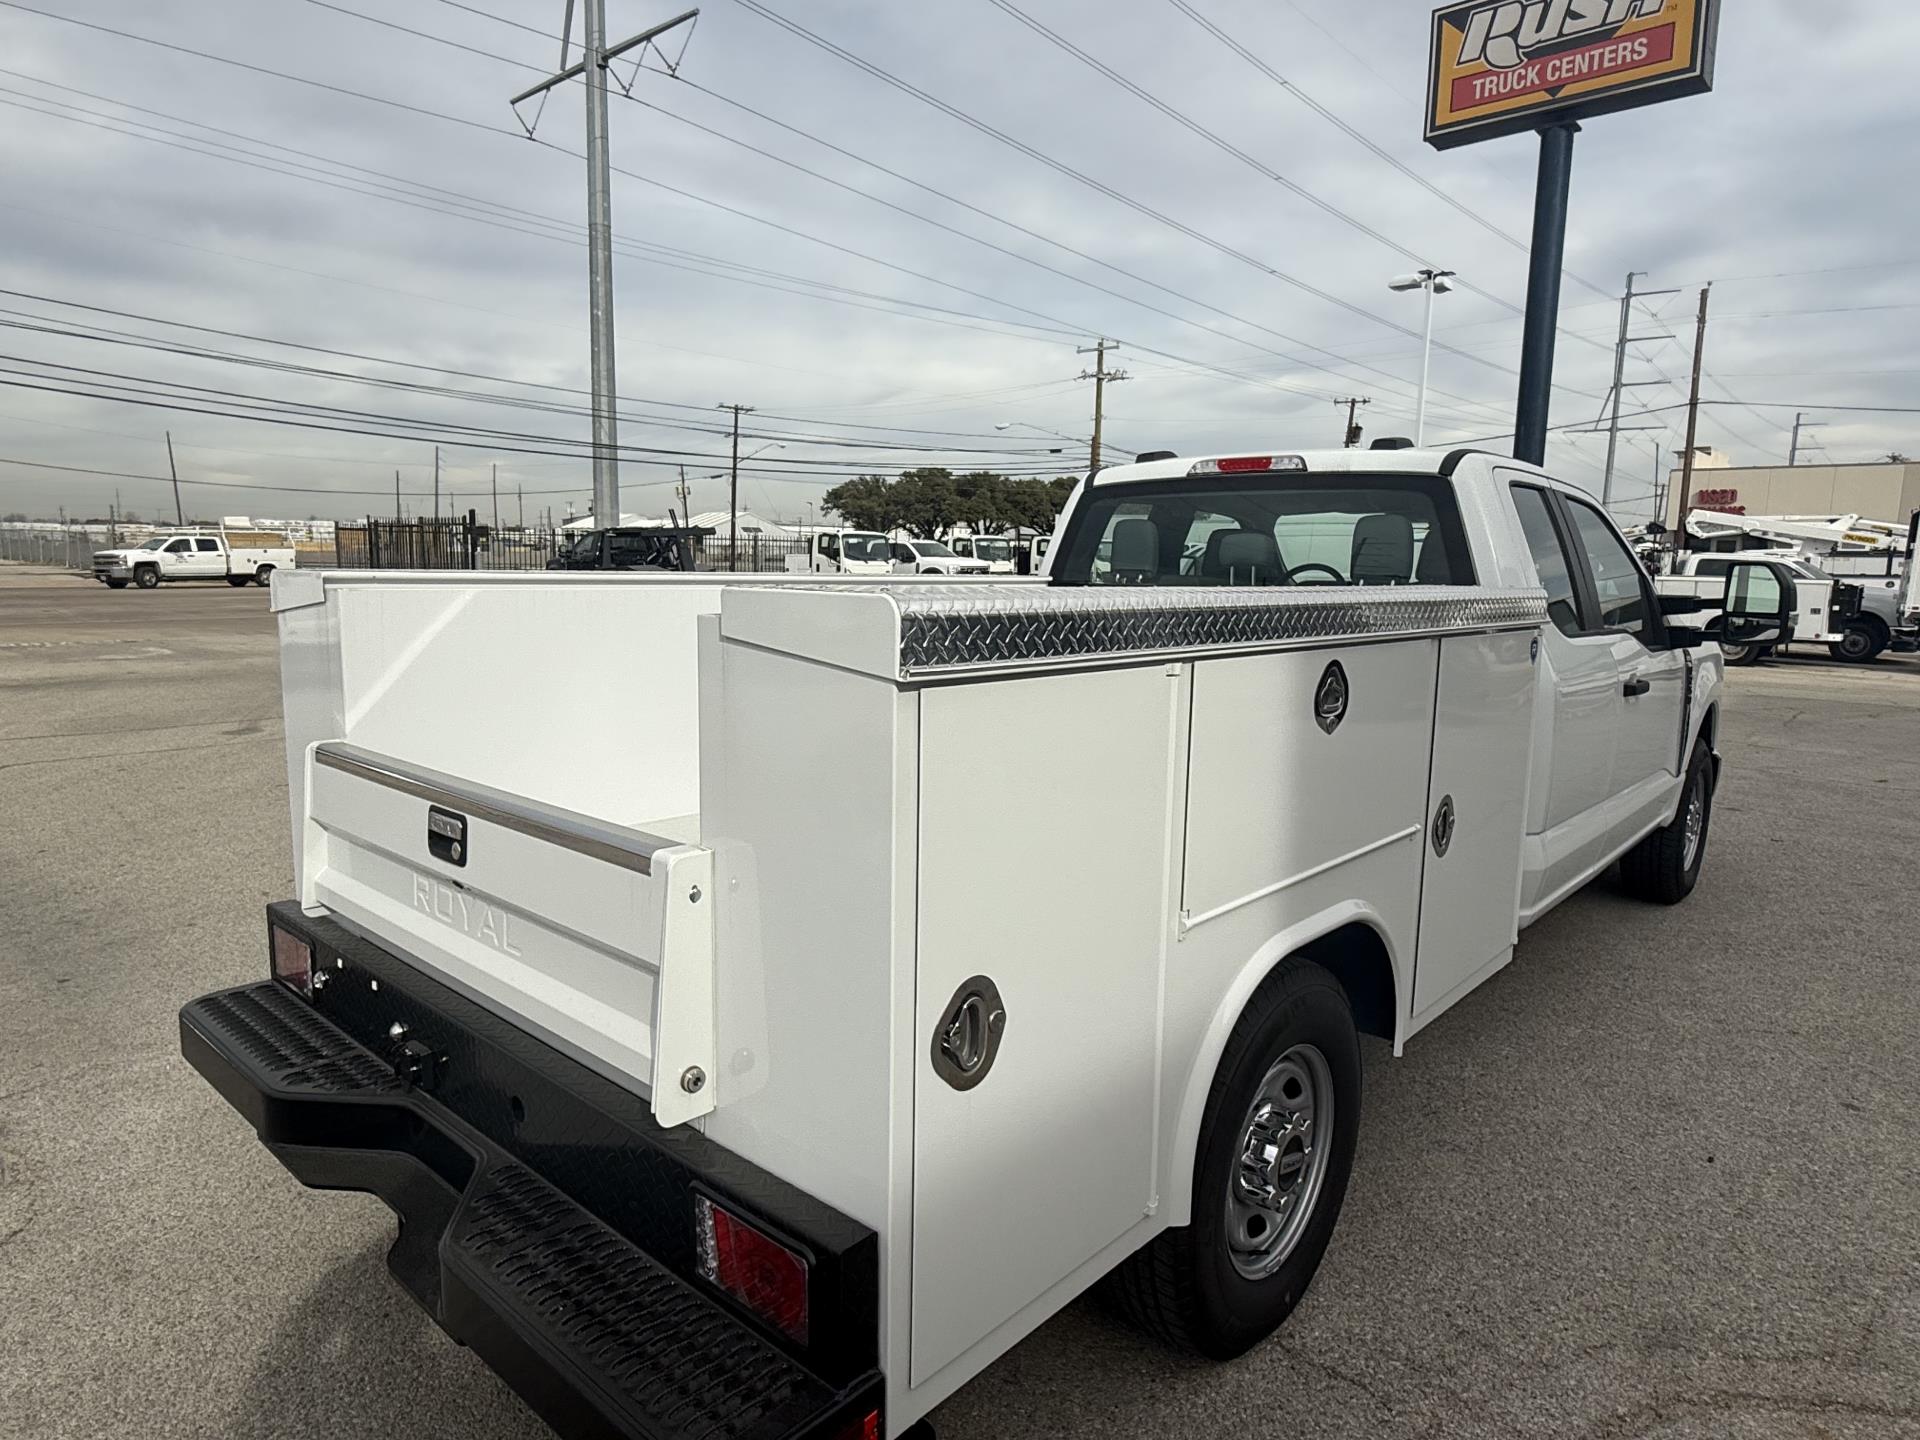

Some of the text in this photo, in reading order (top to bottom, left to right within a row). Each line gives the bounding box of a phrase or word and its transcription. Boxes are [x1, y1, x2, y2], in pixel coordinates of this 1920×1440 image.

[1473, 37, 1648, 100] TRUCK CENTERS
[1698, 489, 1738, 505] USED
[413, 872, 522, 957] ROYAL
